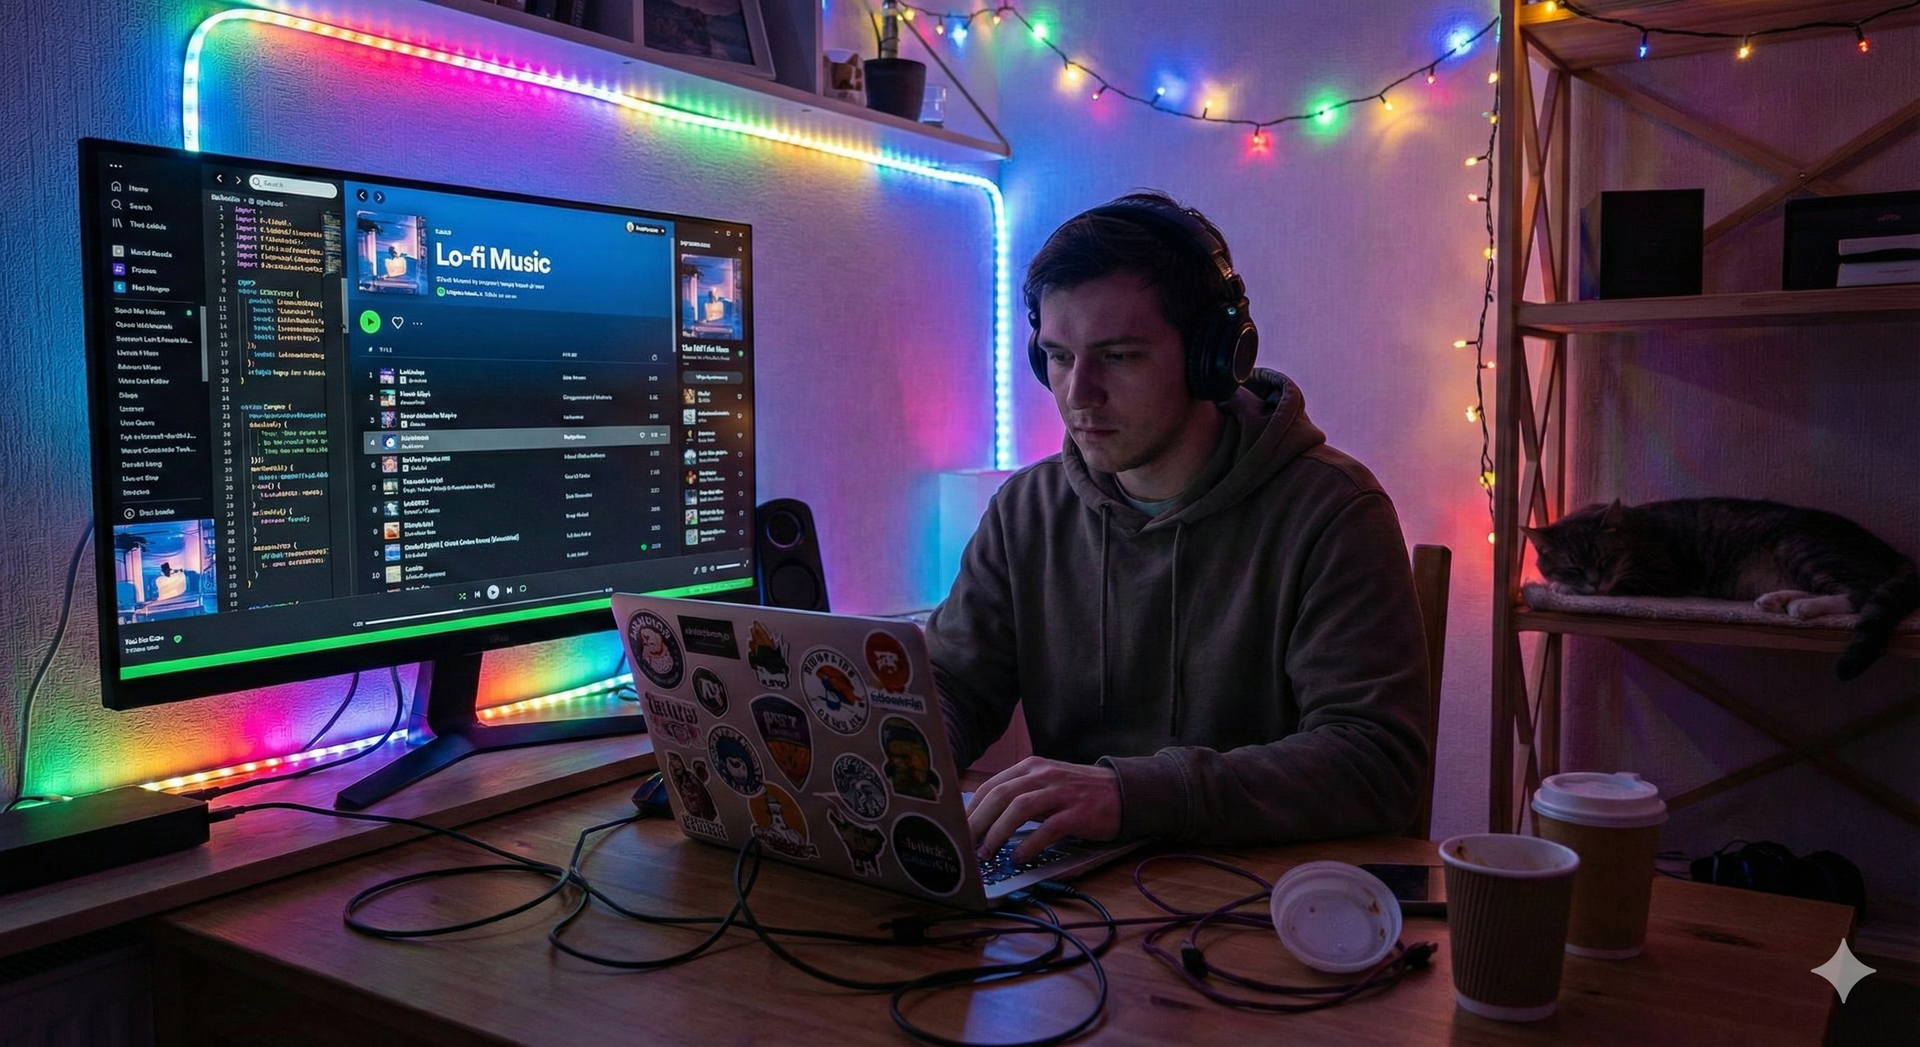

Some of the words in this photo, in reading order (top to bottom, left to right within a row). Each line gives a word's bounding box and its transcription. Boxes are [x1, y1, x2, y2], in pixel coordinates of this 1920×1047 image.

[129, 202, 154, 212] Search
[436, 242, 486, 269] Lo-fi
[490, 247, 551, 274] Music
